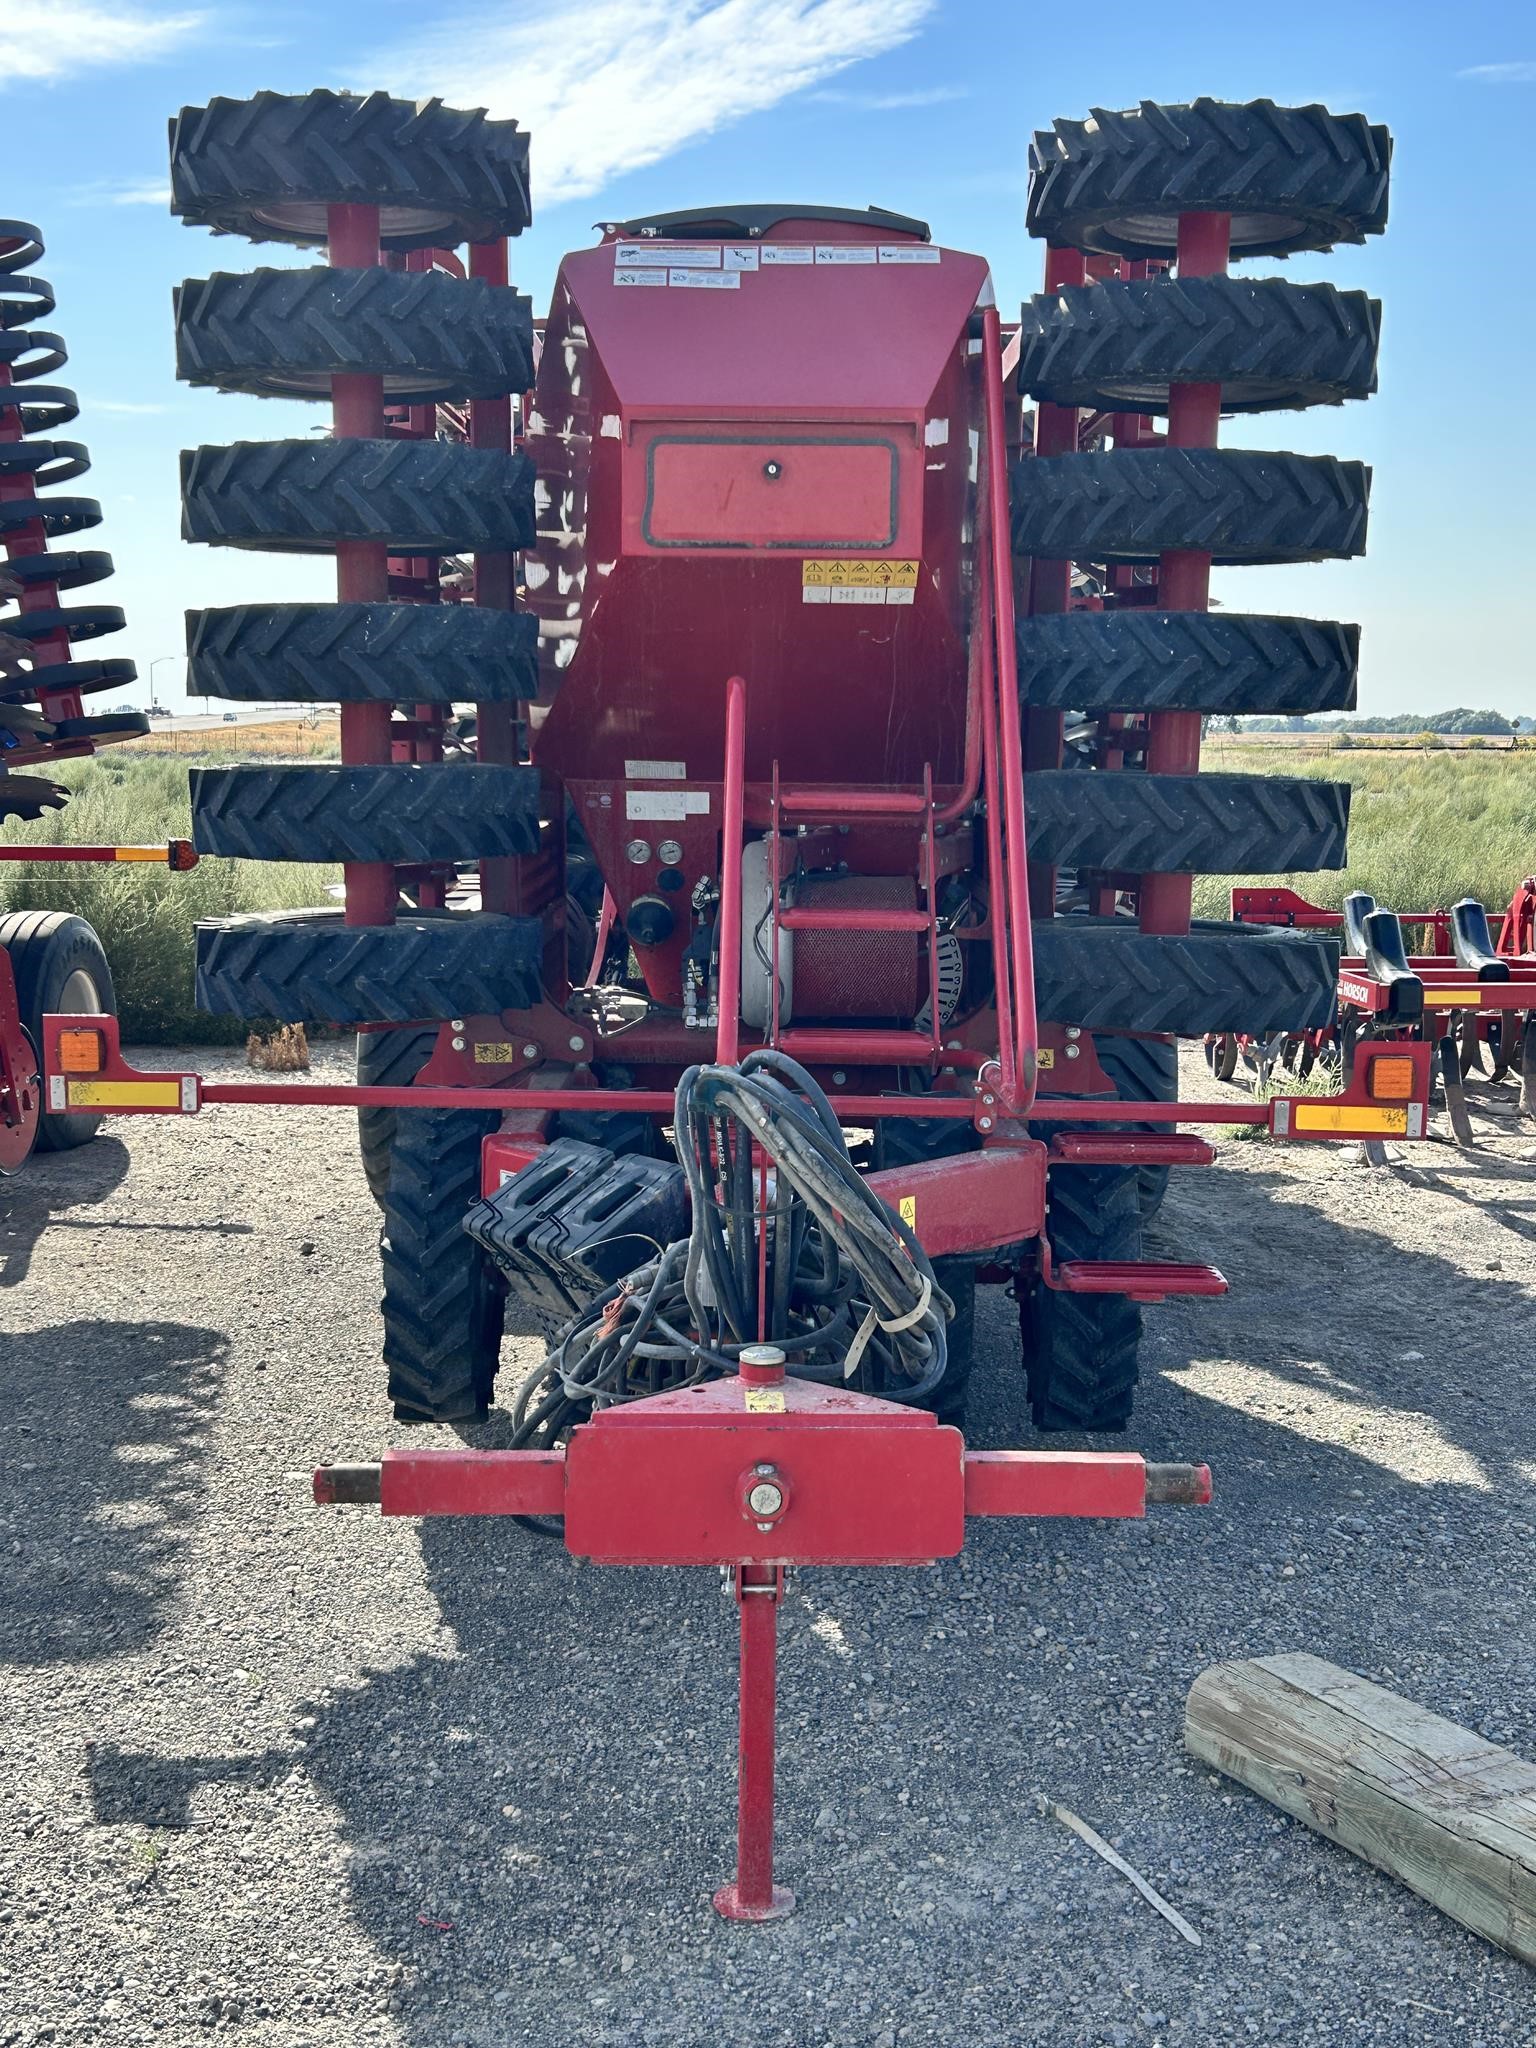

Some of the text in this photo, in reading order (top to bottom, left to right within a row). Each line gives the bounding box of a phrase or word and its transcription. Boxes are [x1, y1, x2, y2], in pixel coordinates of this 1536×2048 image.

[949, 938, 956, 947] 0
[953, 950, 959, 959] 1
[954, 962, 961, 972] 2
[954, 976, 960, 985] 3
[952, 988, 959, 996] 4
[1343, 981, 1369, 1003] HORSCH
[947, 999, 955, 1008] 5
[941, 1010, 950, 1020] 6
